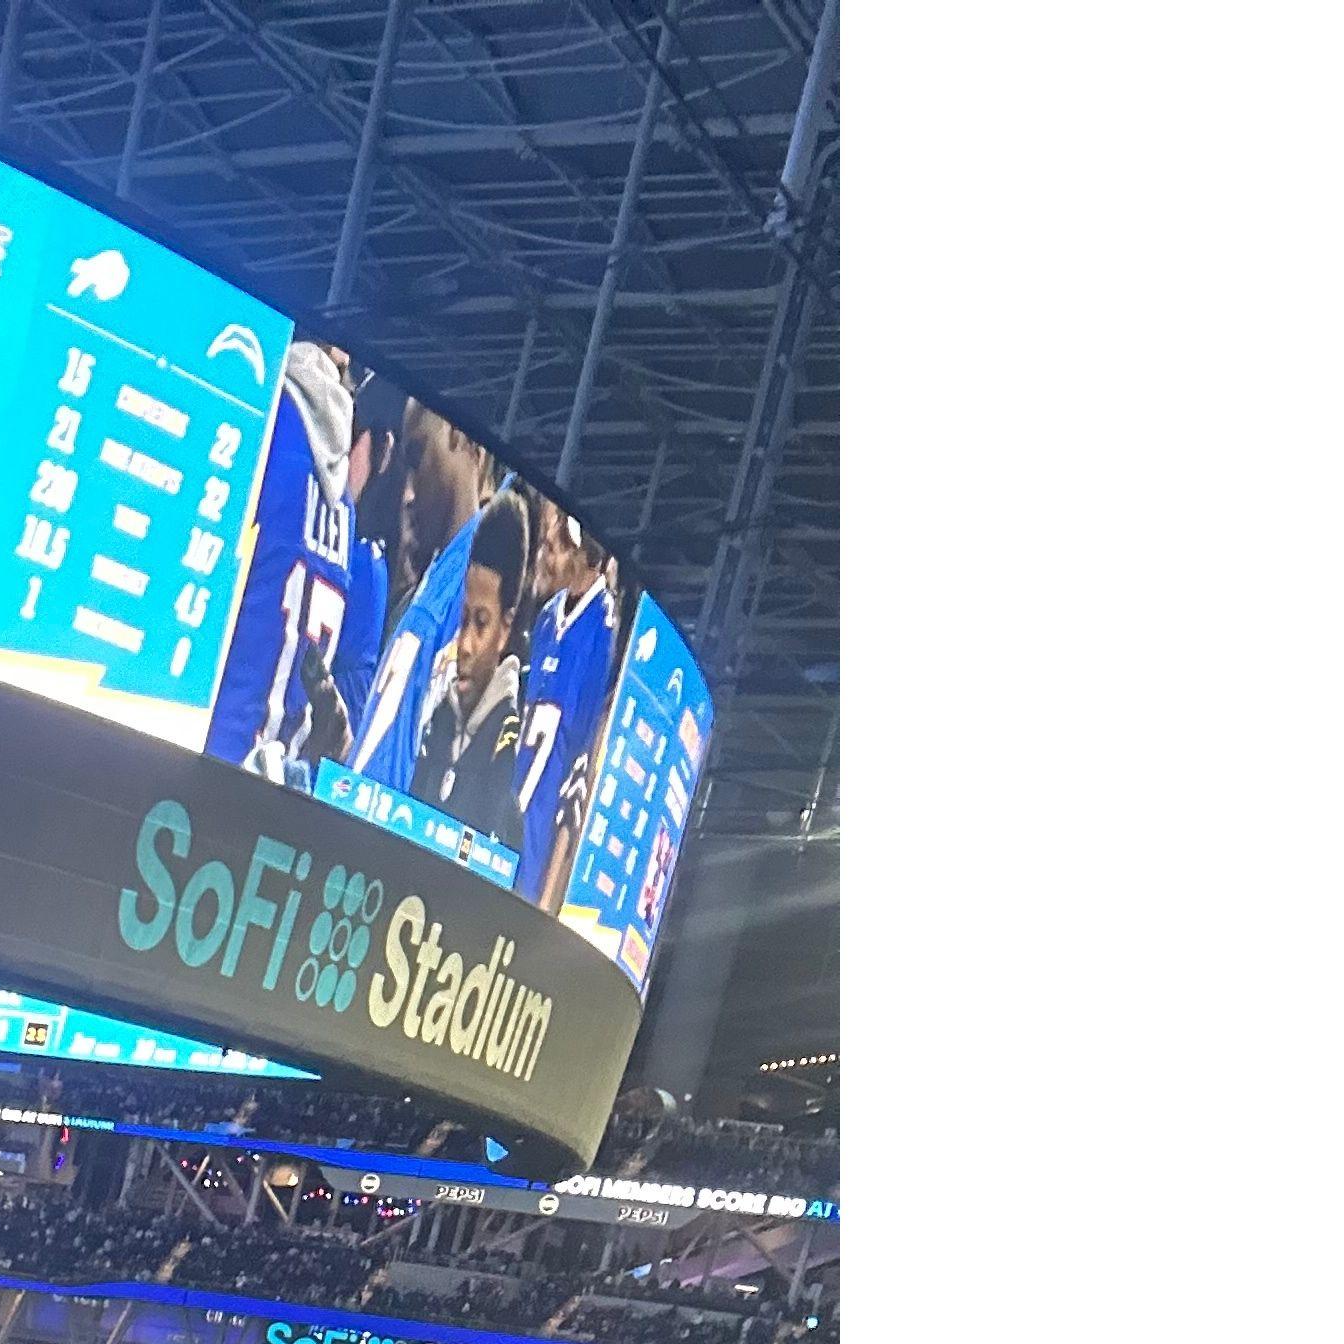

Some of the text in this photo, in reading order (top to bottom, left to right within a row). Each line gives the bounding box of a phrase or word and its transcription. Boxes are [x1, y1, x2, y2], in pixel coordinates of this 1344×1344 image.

[117, 799, 311, 992] SoFi
[368, 895, 554, 1082] Stadium
[435, 1184, 670, 1225] PEPSI PEPSI
